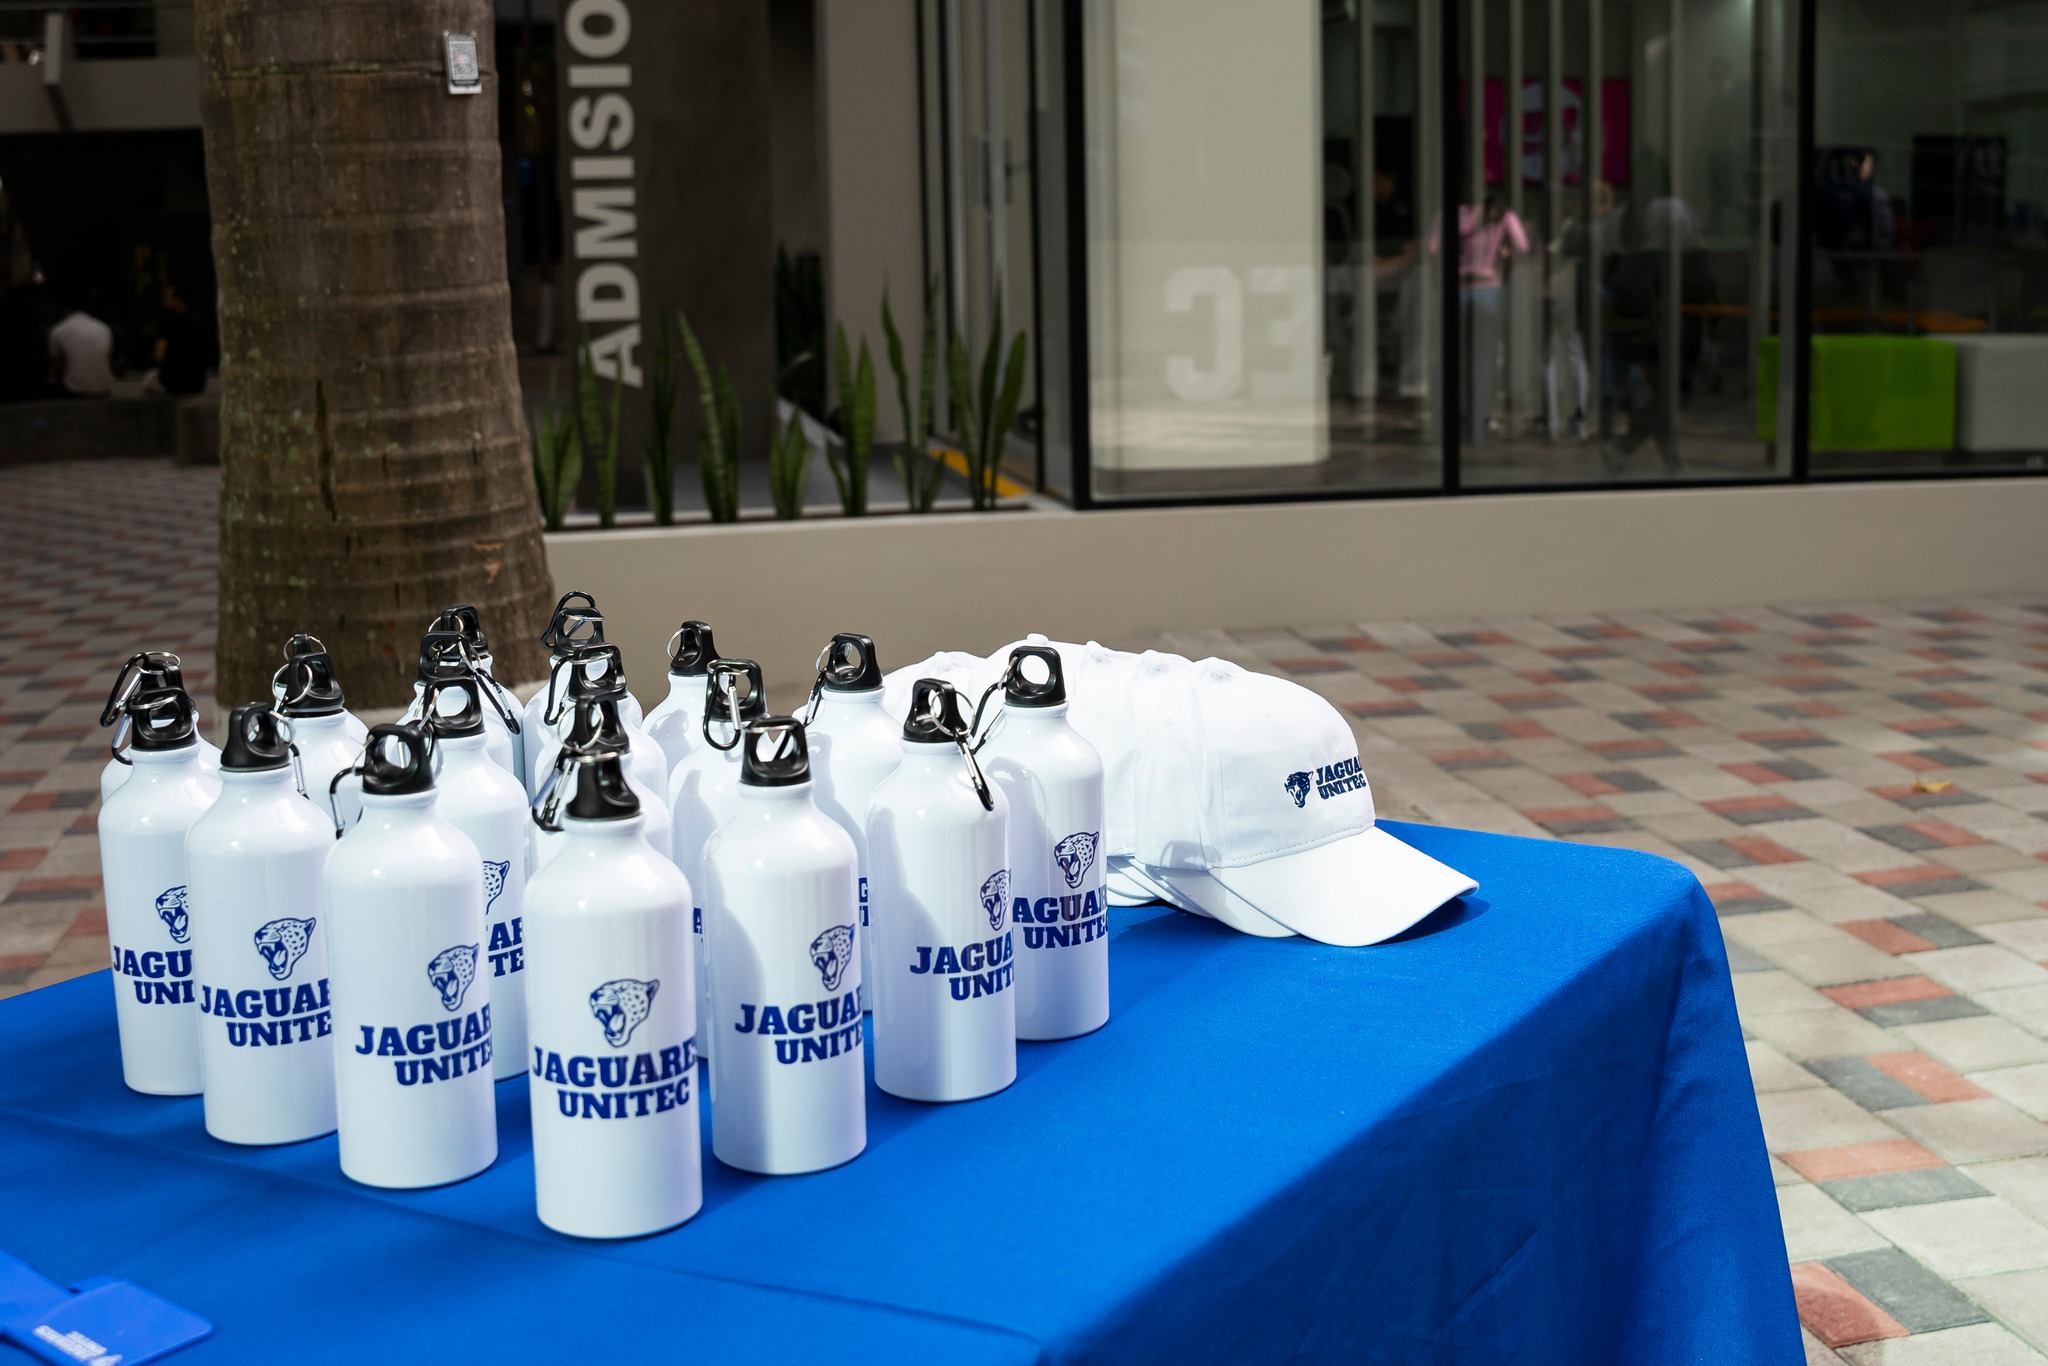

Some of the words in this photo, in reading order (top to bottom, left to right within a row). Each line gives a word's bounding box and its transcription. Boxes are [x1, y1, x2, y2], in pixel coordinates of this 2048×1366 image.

[1317, 773, 1367, 800] UNITEC
[1012, 884, 1108, 924] AGUAR
[113, 945, 193, 978] JAGU
[910, 926, 1014, 975] JAGUA
[133, 979, 196, 1005] UNI
[949, 959, 1015, 1001] UNIT
[226, 1009, 333, 1047] UNITE
[735, 985, 862, 1035] JAGUA
[394, 1032, 494, 1086] UNITE
[557, 1076, 690, 1120] UNITEC
